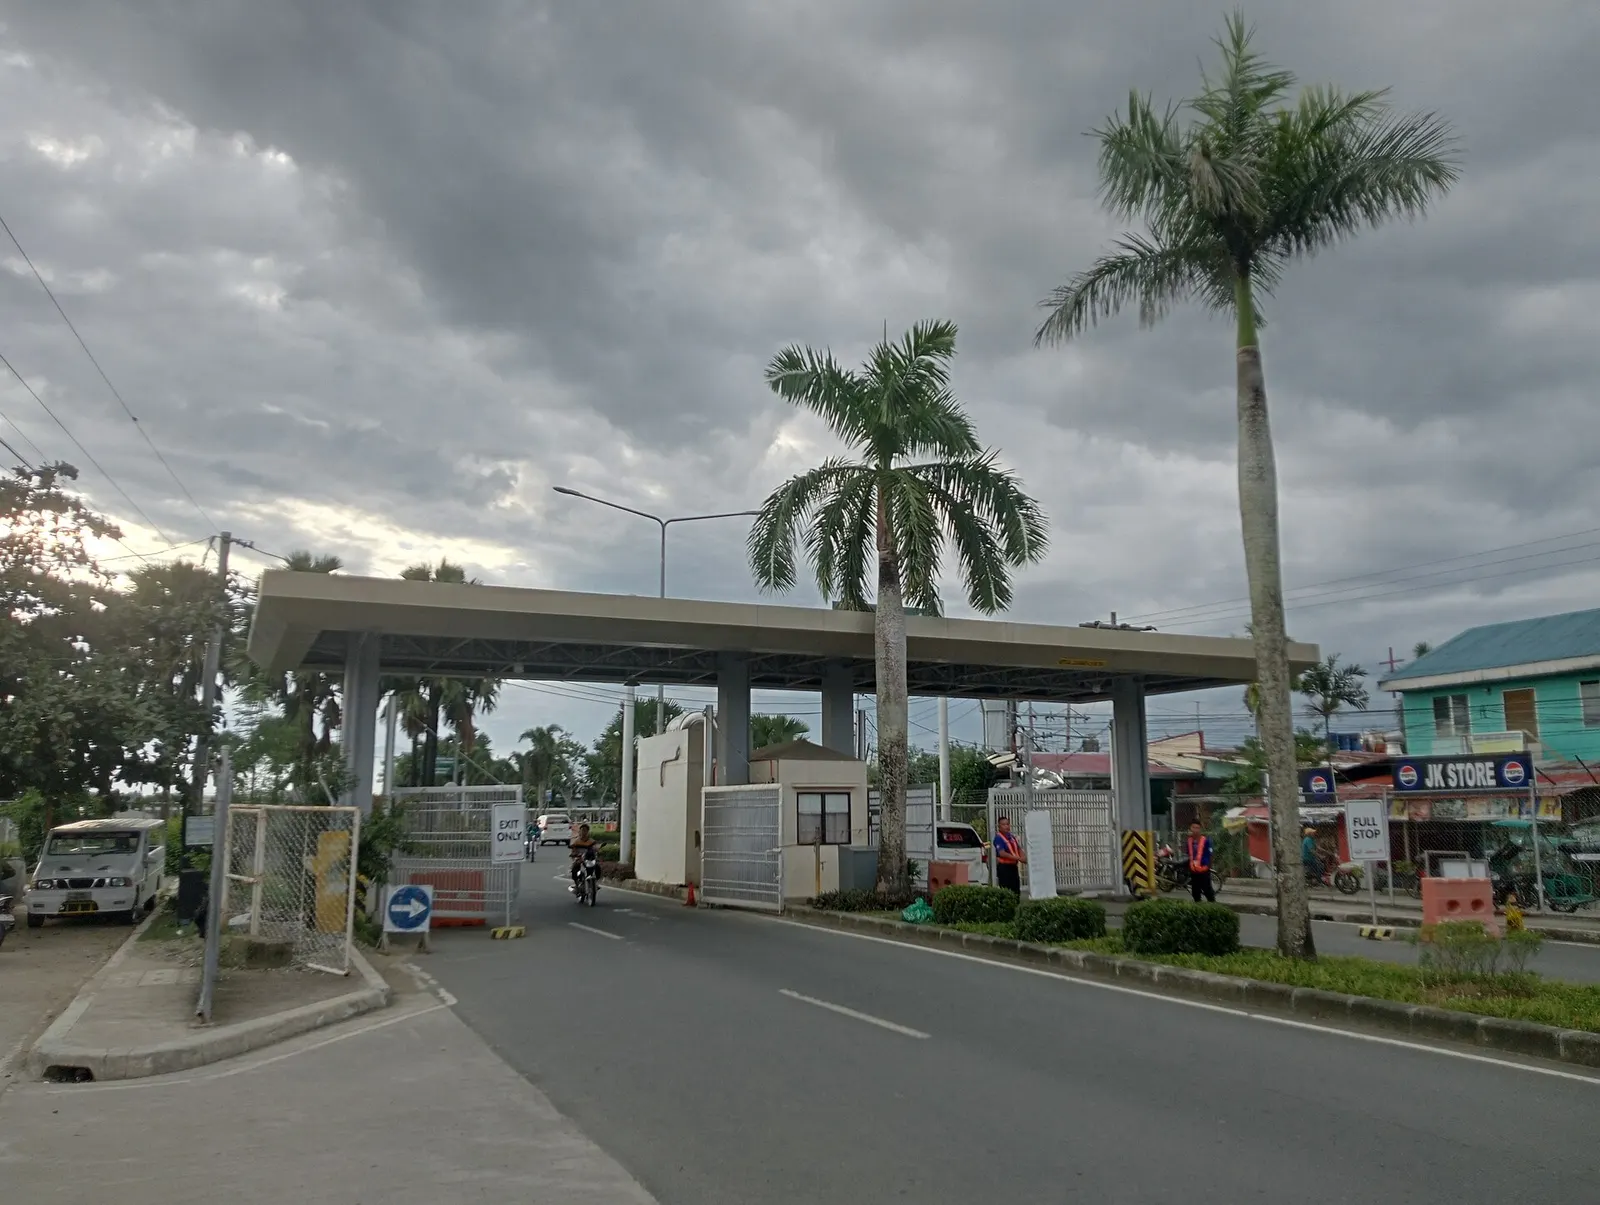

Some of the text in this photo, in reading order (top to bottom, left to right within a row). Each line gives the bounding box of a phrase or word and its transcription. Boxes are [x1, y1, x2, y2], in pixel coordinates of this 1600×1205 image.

[1425, 761, 1497, 788] JK STORE
[500, 819, 519, 830] EXIT
[1353, 816, 1378, 827] FULL
[497, 831, 522, 842] ONLY
[1353, 829, 1380, 840] STOP
